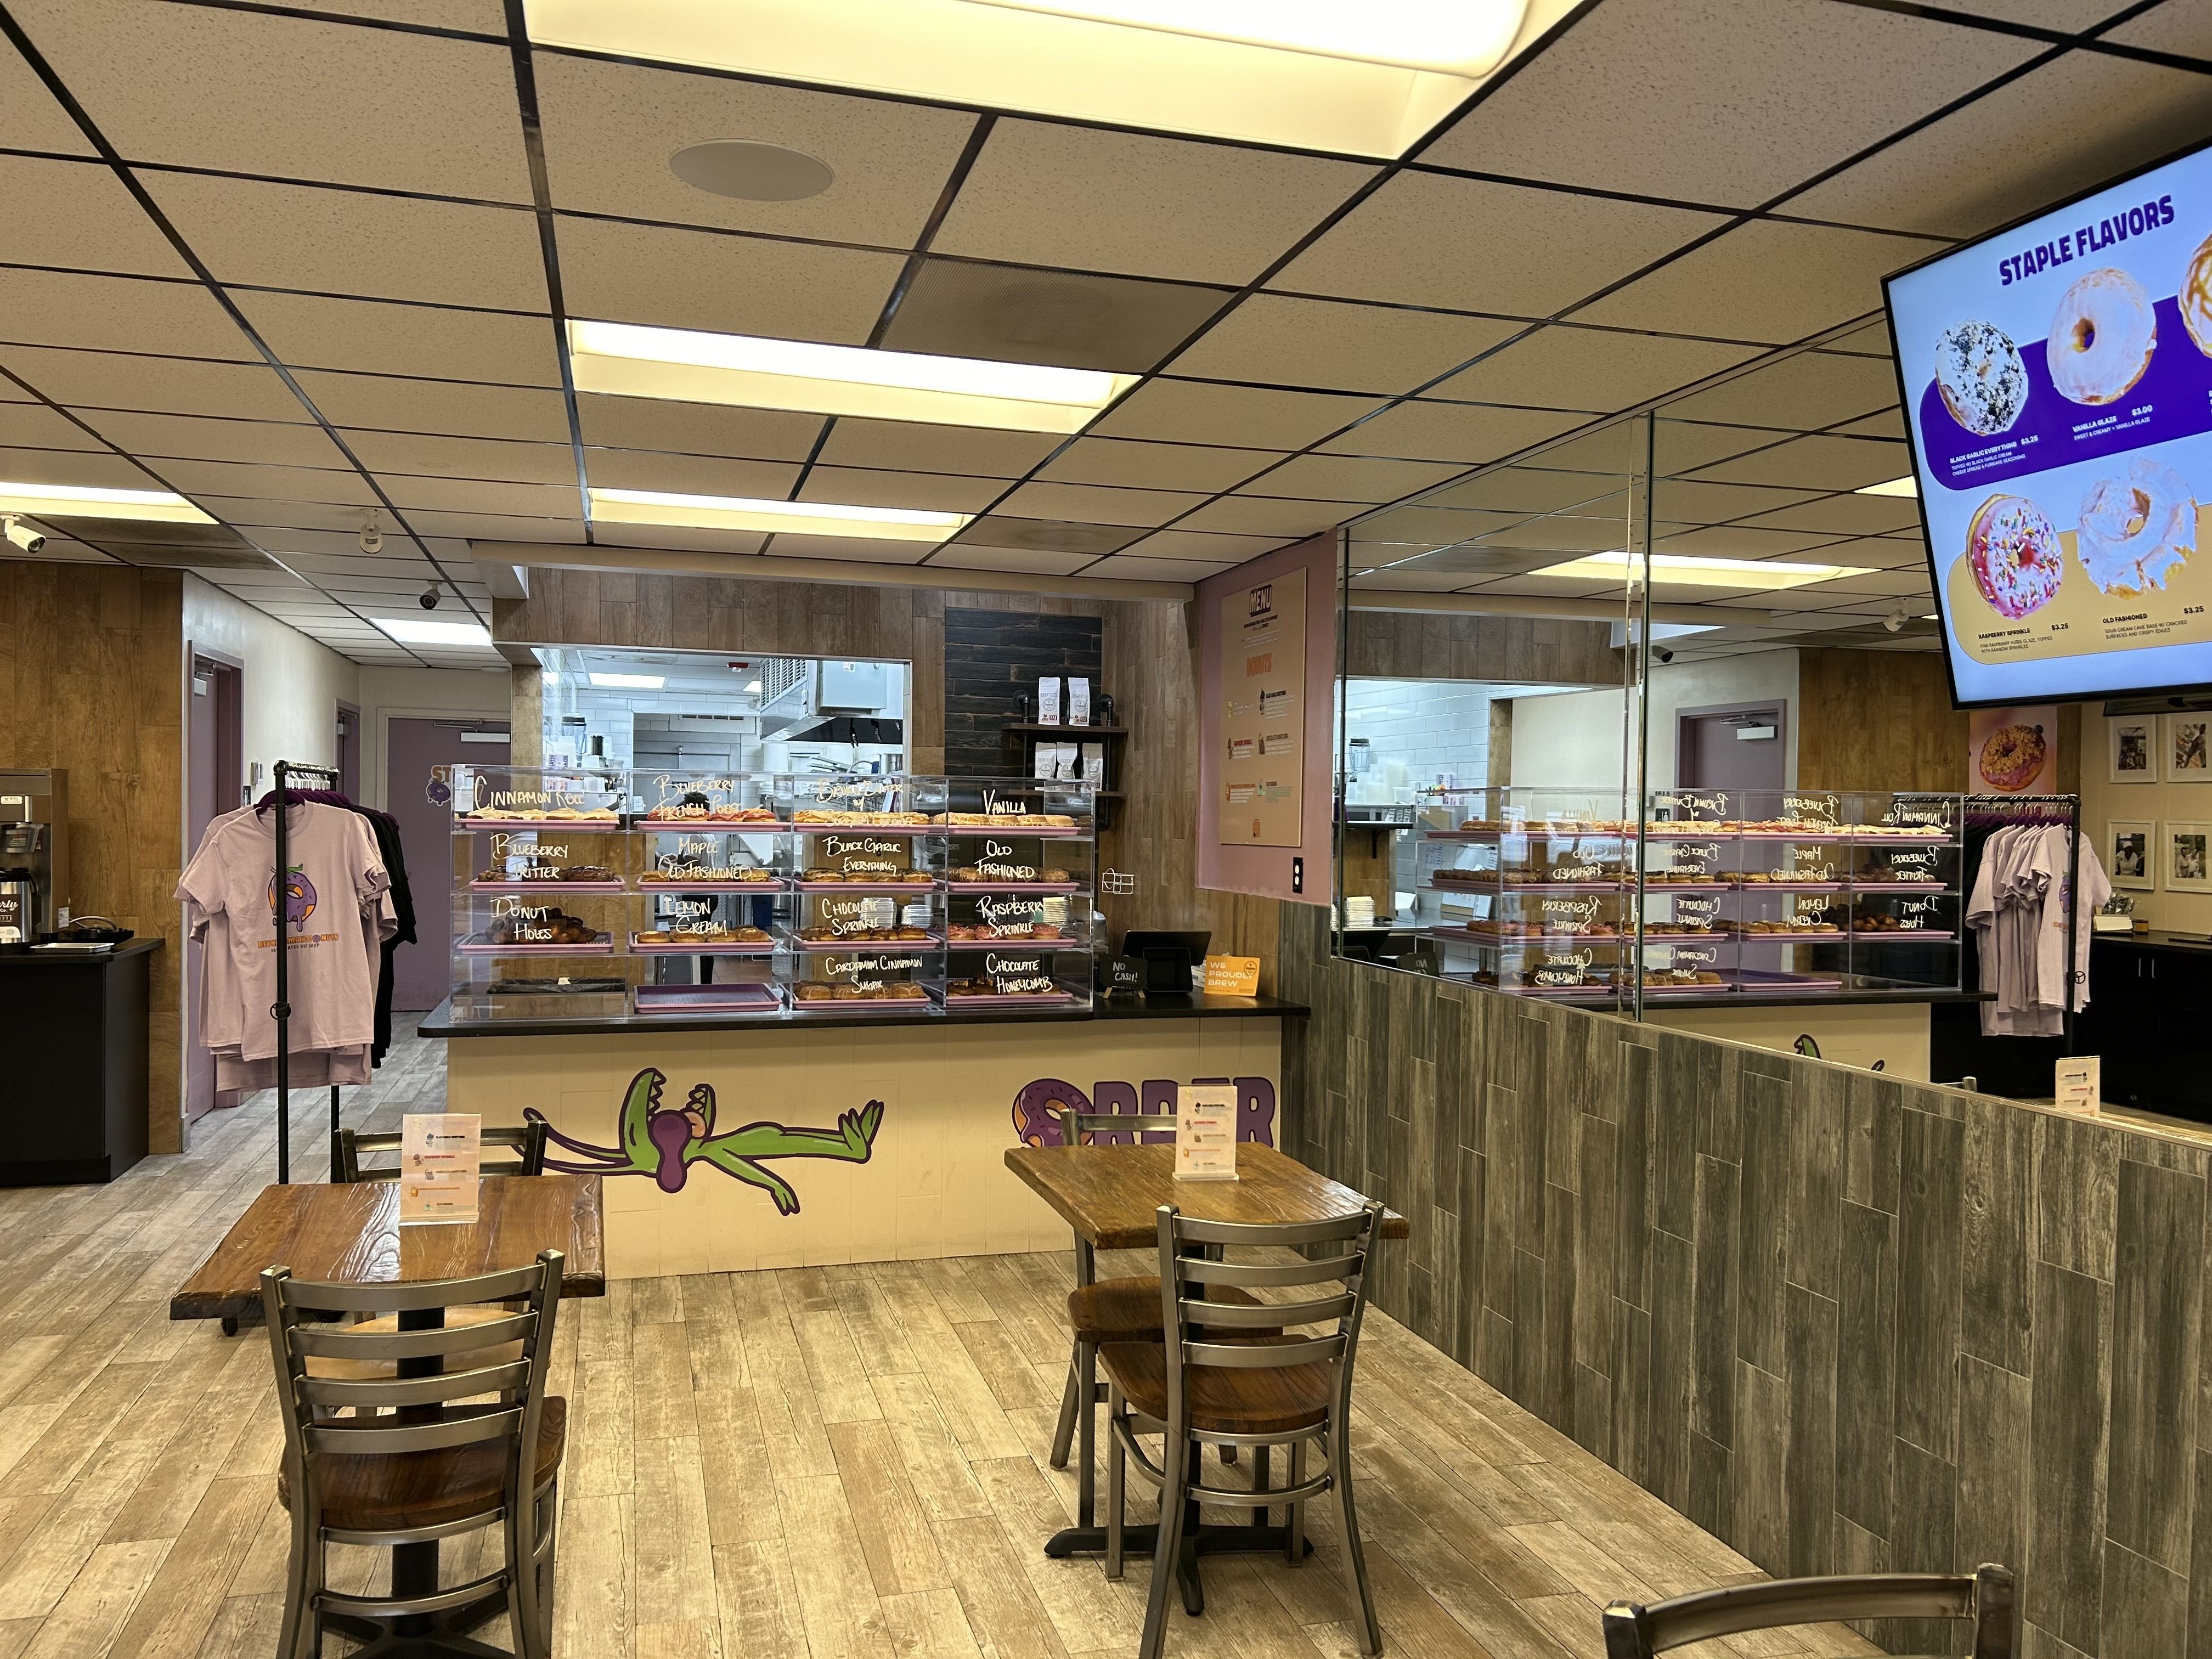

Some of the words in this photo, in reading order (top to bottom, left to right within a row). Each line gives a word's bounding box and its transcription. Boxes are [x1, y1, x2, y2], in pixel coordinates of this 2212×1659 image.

[1999, 234, 2074, 286] STAPLE
[2075, 194, 2174, 257] FLAVORS
[2131, 405, 2153, 415] $3.00
[2072, 421, 2097, 432] VANILLA
[2097, 415, 2117, 425] GLAZE
[2021, 435, 2039, 445] $3.25
[1950, 454, 1967, 464] BLACK
[1966, 450, 1984, 460] GARLIC
[1984, 441, 2017, 455] EVERYTHING
[1250, 586, 1272, 615] MENU
[2115, 613, 2148, 622] FASHIONED
[2007, 628, 2031, 636] SPRINKLE
[475, 775, 551, 810] CINNAMON
[653, 774, 734, 802] BLUEBERRY
[983, 789, 1026, 815] VANILLA
[490, 833, 568, 859] BLUEBERRY
[678, 837, 723, 855] MAPLE
[822, 836, 863, 857] BLACK
[864, 838, 901, 854] GARLIC
[986, 839, 1012, 856] OLD
[974, 856, 1035, 880] FASHIONED
[490, 898, 549, 922] DONUT
[665, 897, 710, 917] LEMON
[822, 898, 879, 919] CHOCOLATE
[976, 895, 1047, 918] RASPBERRY
[514, 923, 552, 940] HOLES
[675, 915, 727, 936] CREAM
[832, 917, 879, 936] SPRINKLE
[988, 917, 1034, 938] SPRINKLE
[986, 953, 1040, 973] CHOCOLATE
[1113, 961, 1126, 971] NO
[1210, 961, 1227, 969] WE
[851, 975, 883, 994] SUGAR
[1115, 971, 1138, 982] CASH!
[1208, 979, 1238, 987] BREW
[1209, 970, 1252, 979] PROUDLY
[996, 975, 1052, 995] HONEYCOMB
